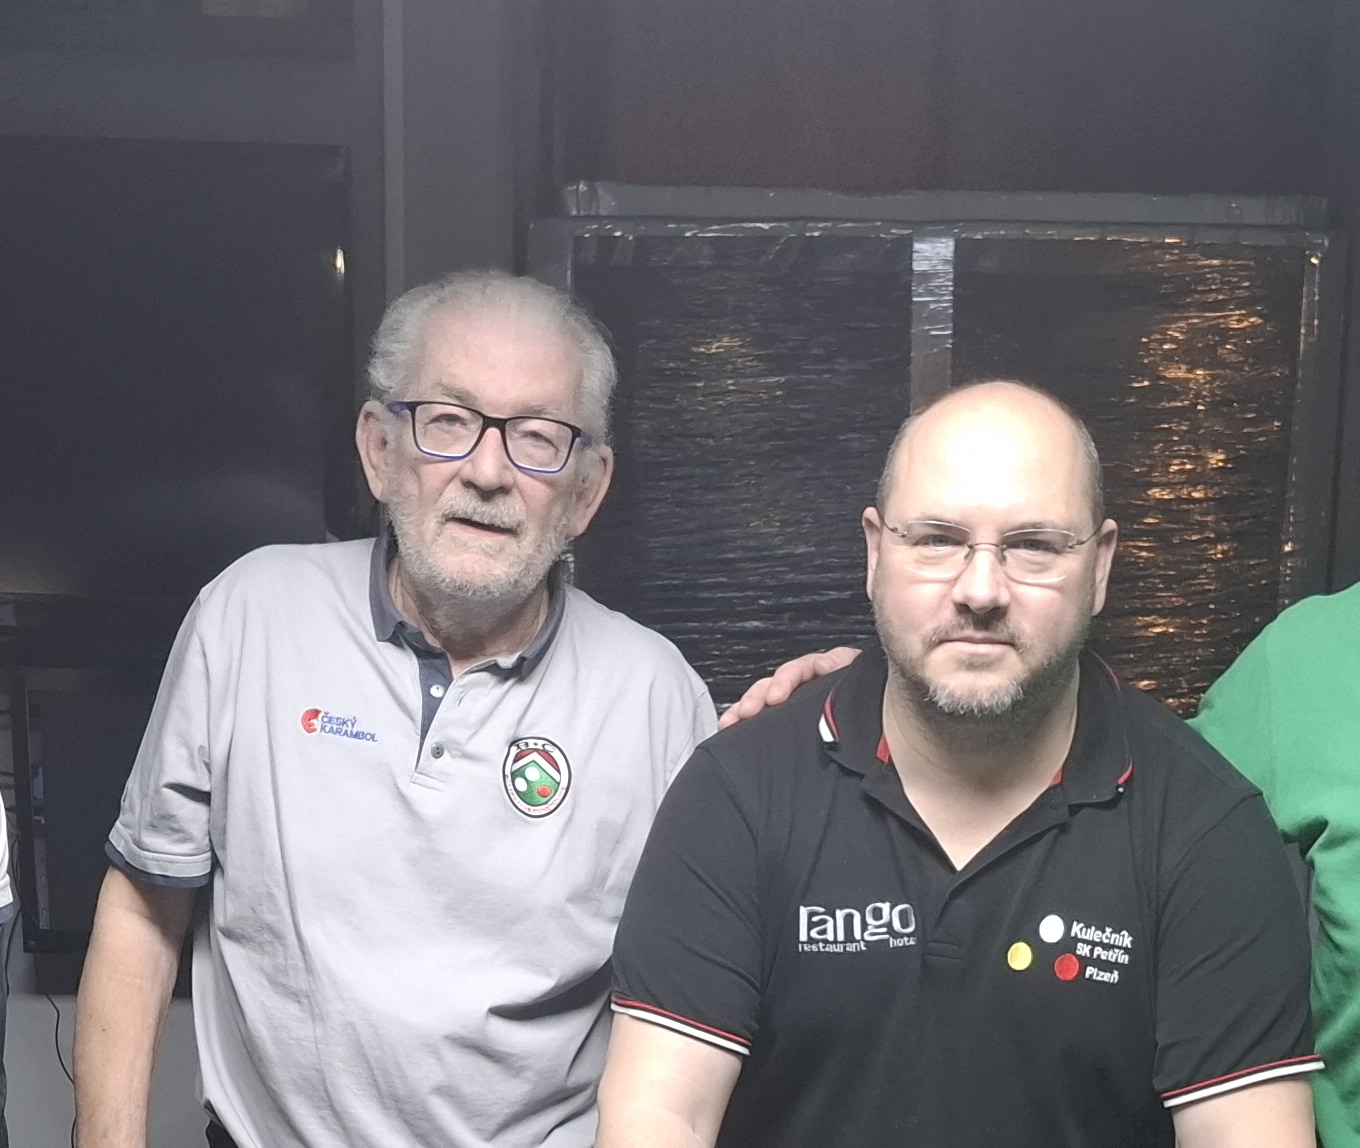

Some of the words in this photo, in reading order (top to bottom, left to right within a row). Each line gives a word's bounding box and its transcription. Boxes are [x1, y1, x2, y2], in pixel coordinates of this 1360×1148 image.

[321, 711, 357, 729] ČESKÝ
[320, 723, 378, 742] KARAMBOL
[798, 940, 868, 953] restaurant
[1075, 942, 1092, 958] SK
[1085, 965, 1119, 984] Plzeň
